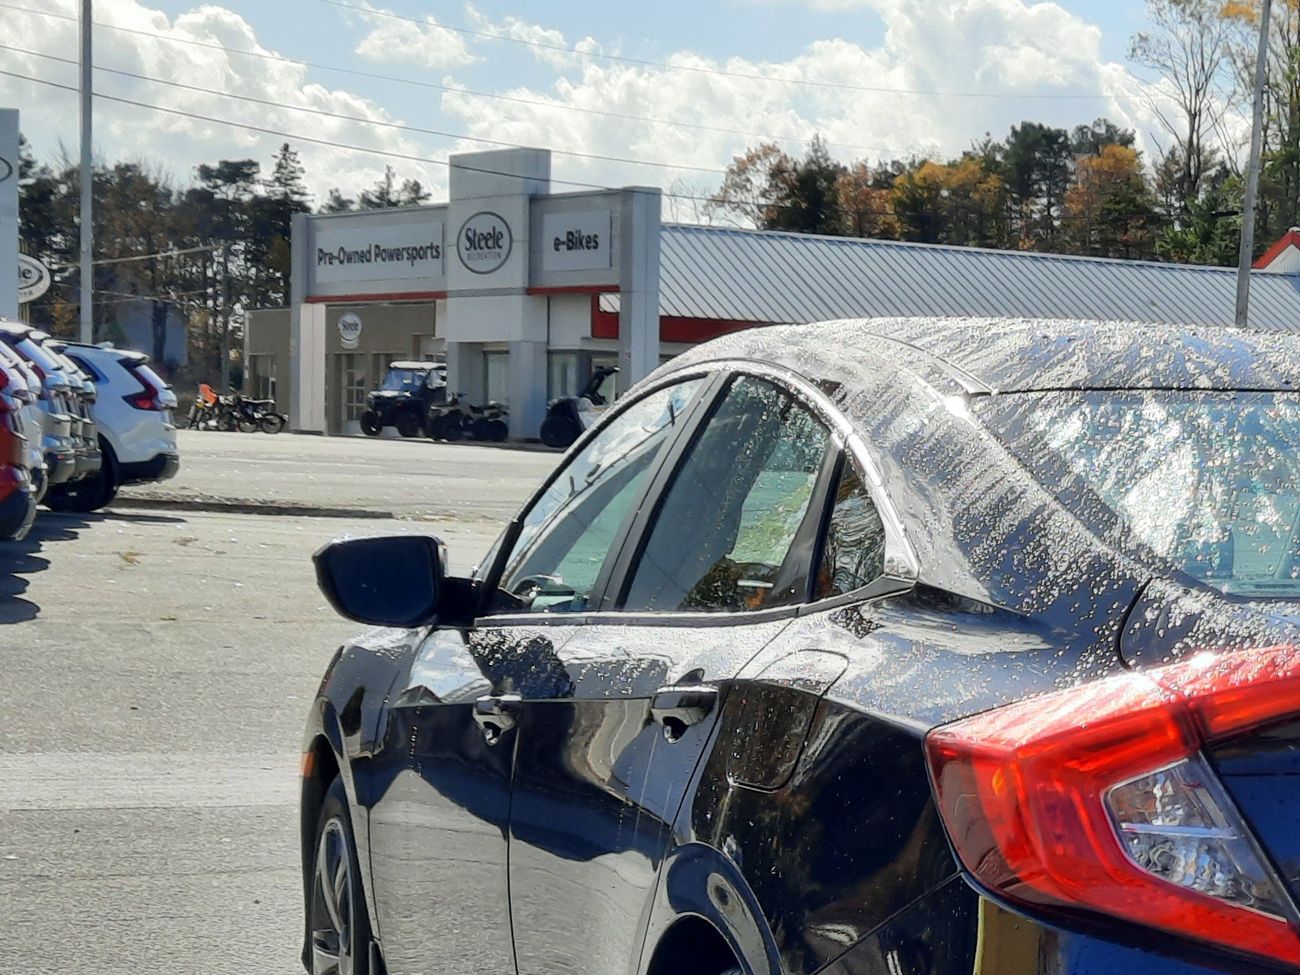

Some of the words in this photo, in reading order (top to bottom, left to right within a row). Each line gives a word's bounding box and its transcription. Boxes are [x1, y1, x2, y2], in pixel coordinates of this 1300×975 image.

[464, 225, 504, 252] Steele
[553, 229, 599, 252] e-Bikes
[317, 243, 372, 265] Pre-Owned
[373, 241, 441, 267] Powersports
